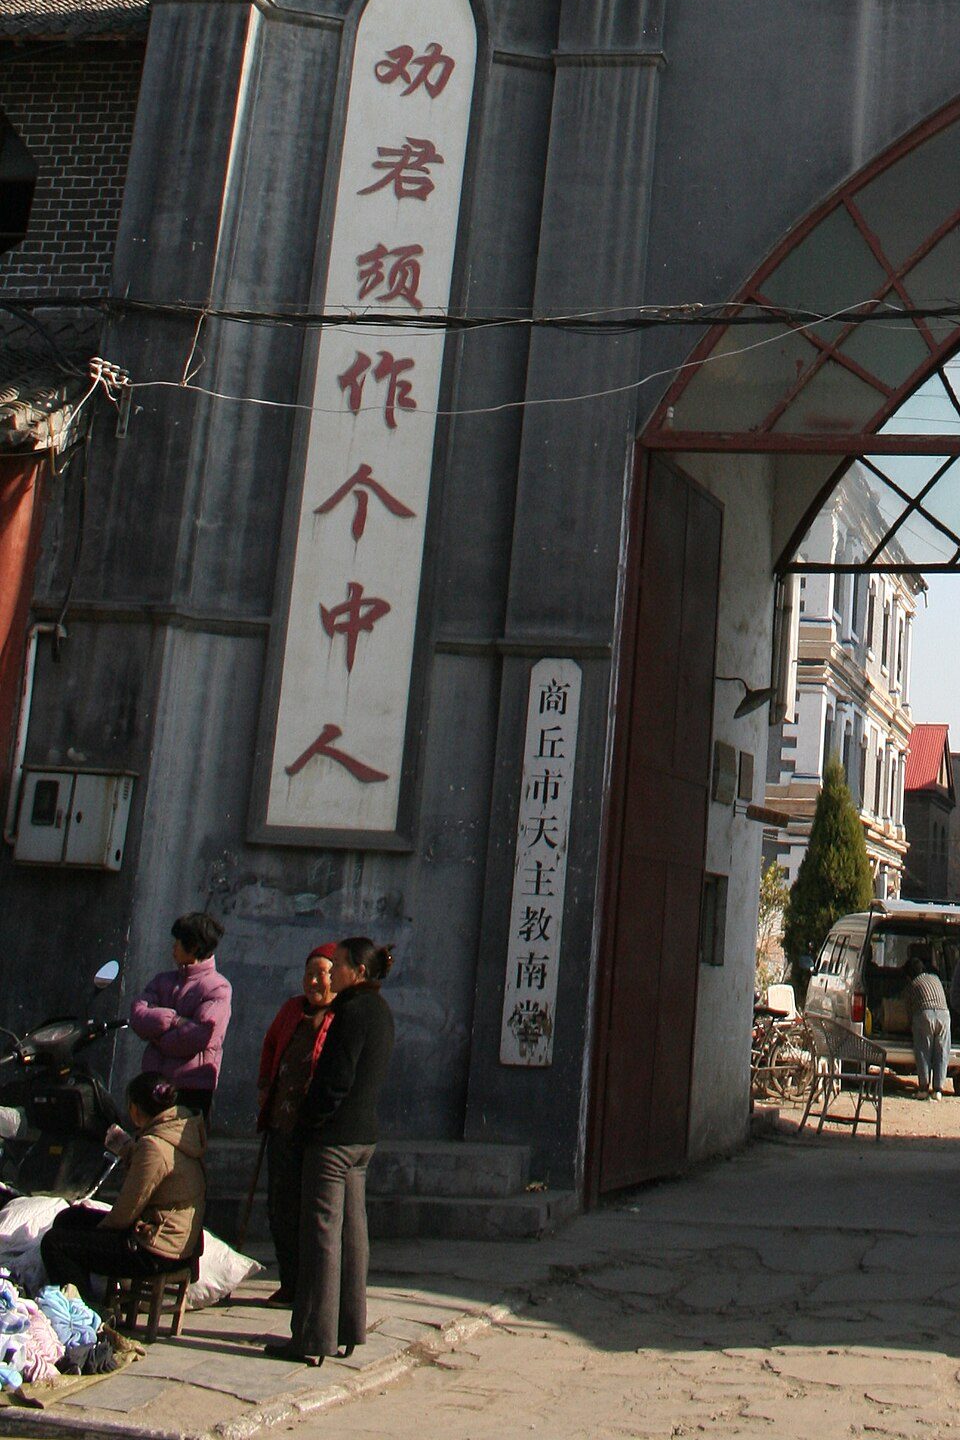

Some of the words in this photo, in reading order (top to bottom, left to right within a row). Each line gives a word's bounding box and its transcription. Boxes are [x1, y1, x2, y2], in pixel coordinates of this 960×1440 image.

[508, 678, 571, 1044] 商丘市天主教南堂
